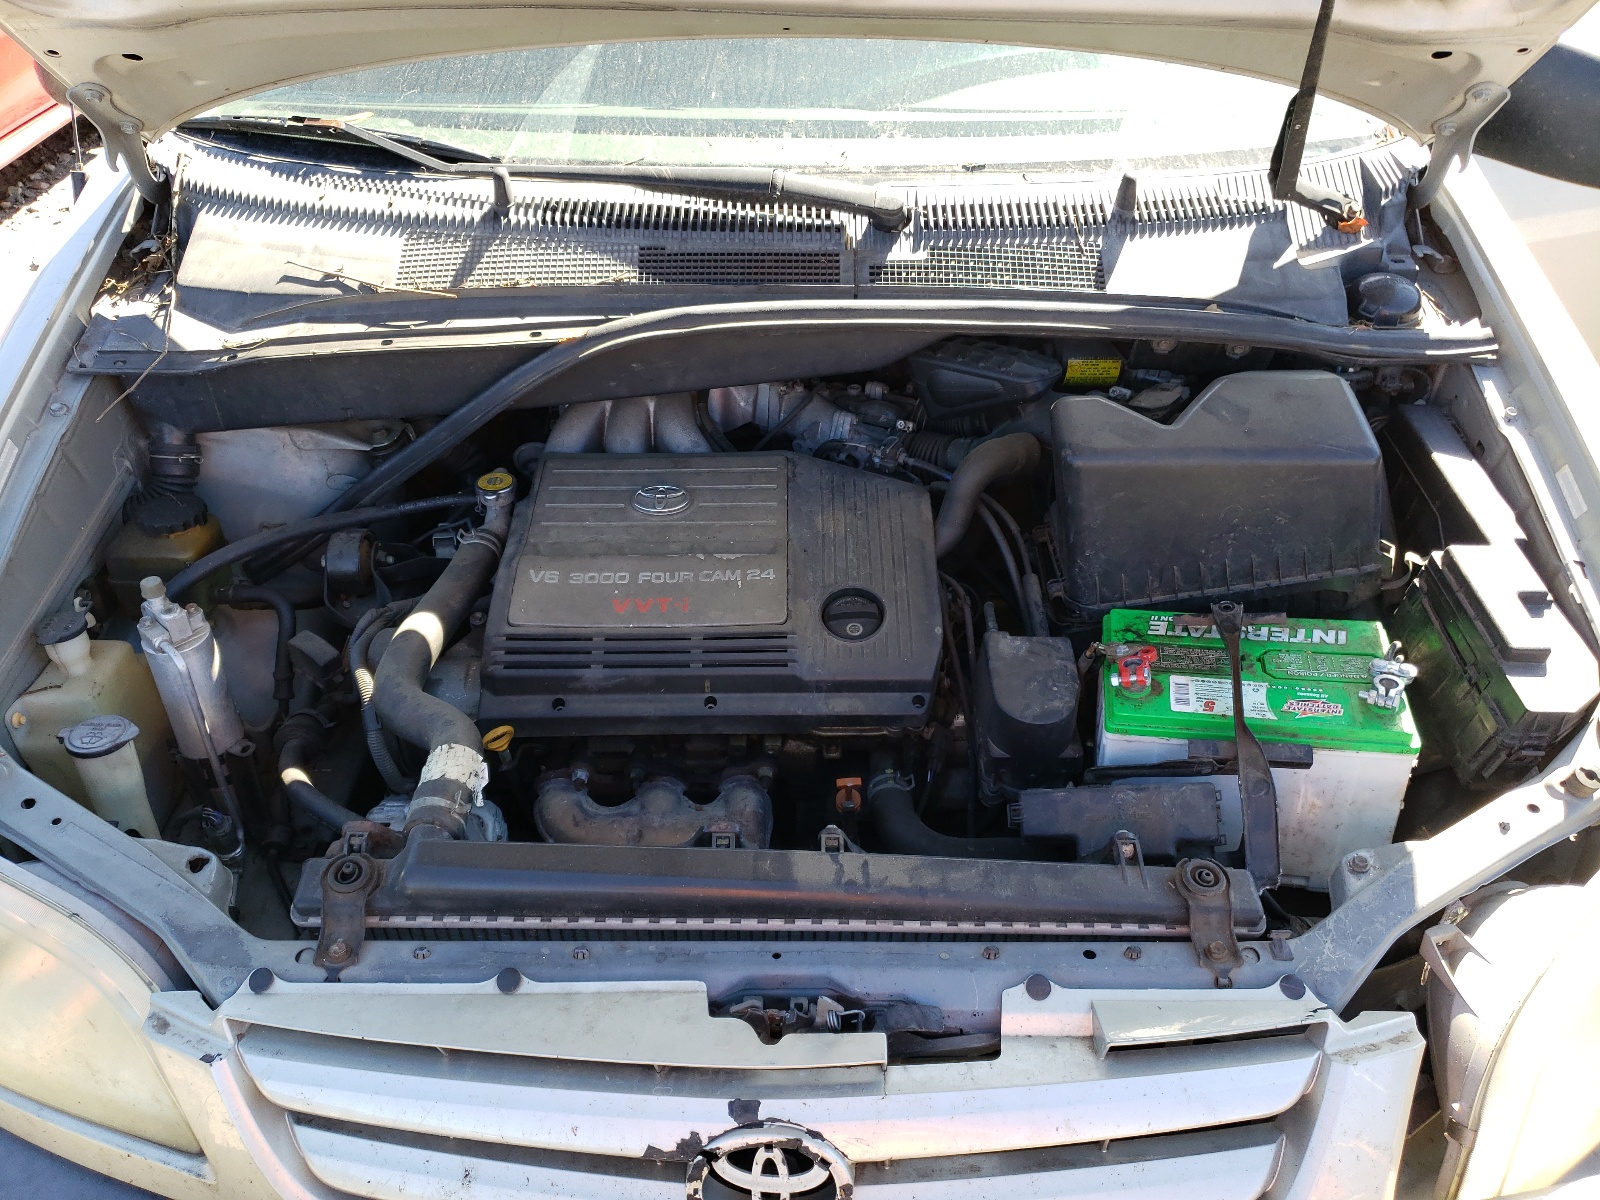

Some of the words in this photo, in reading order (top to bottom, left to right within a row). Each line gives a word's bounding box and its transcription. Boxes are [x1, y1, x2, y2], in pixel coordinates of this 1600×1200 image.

[529, 569, 560, 583] V6
[569, 572, 630, 584] 3000
[638, 571, 694, 584] FOUR
[698, 570, 741, 583] CAM
[745, 568, 776, 580] 24
[612, 597, 690, 613] VVT-i
[1202, 700, 1216, 713] 5
[1284, 705, 1342, 715] INTERSTATE
